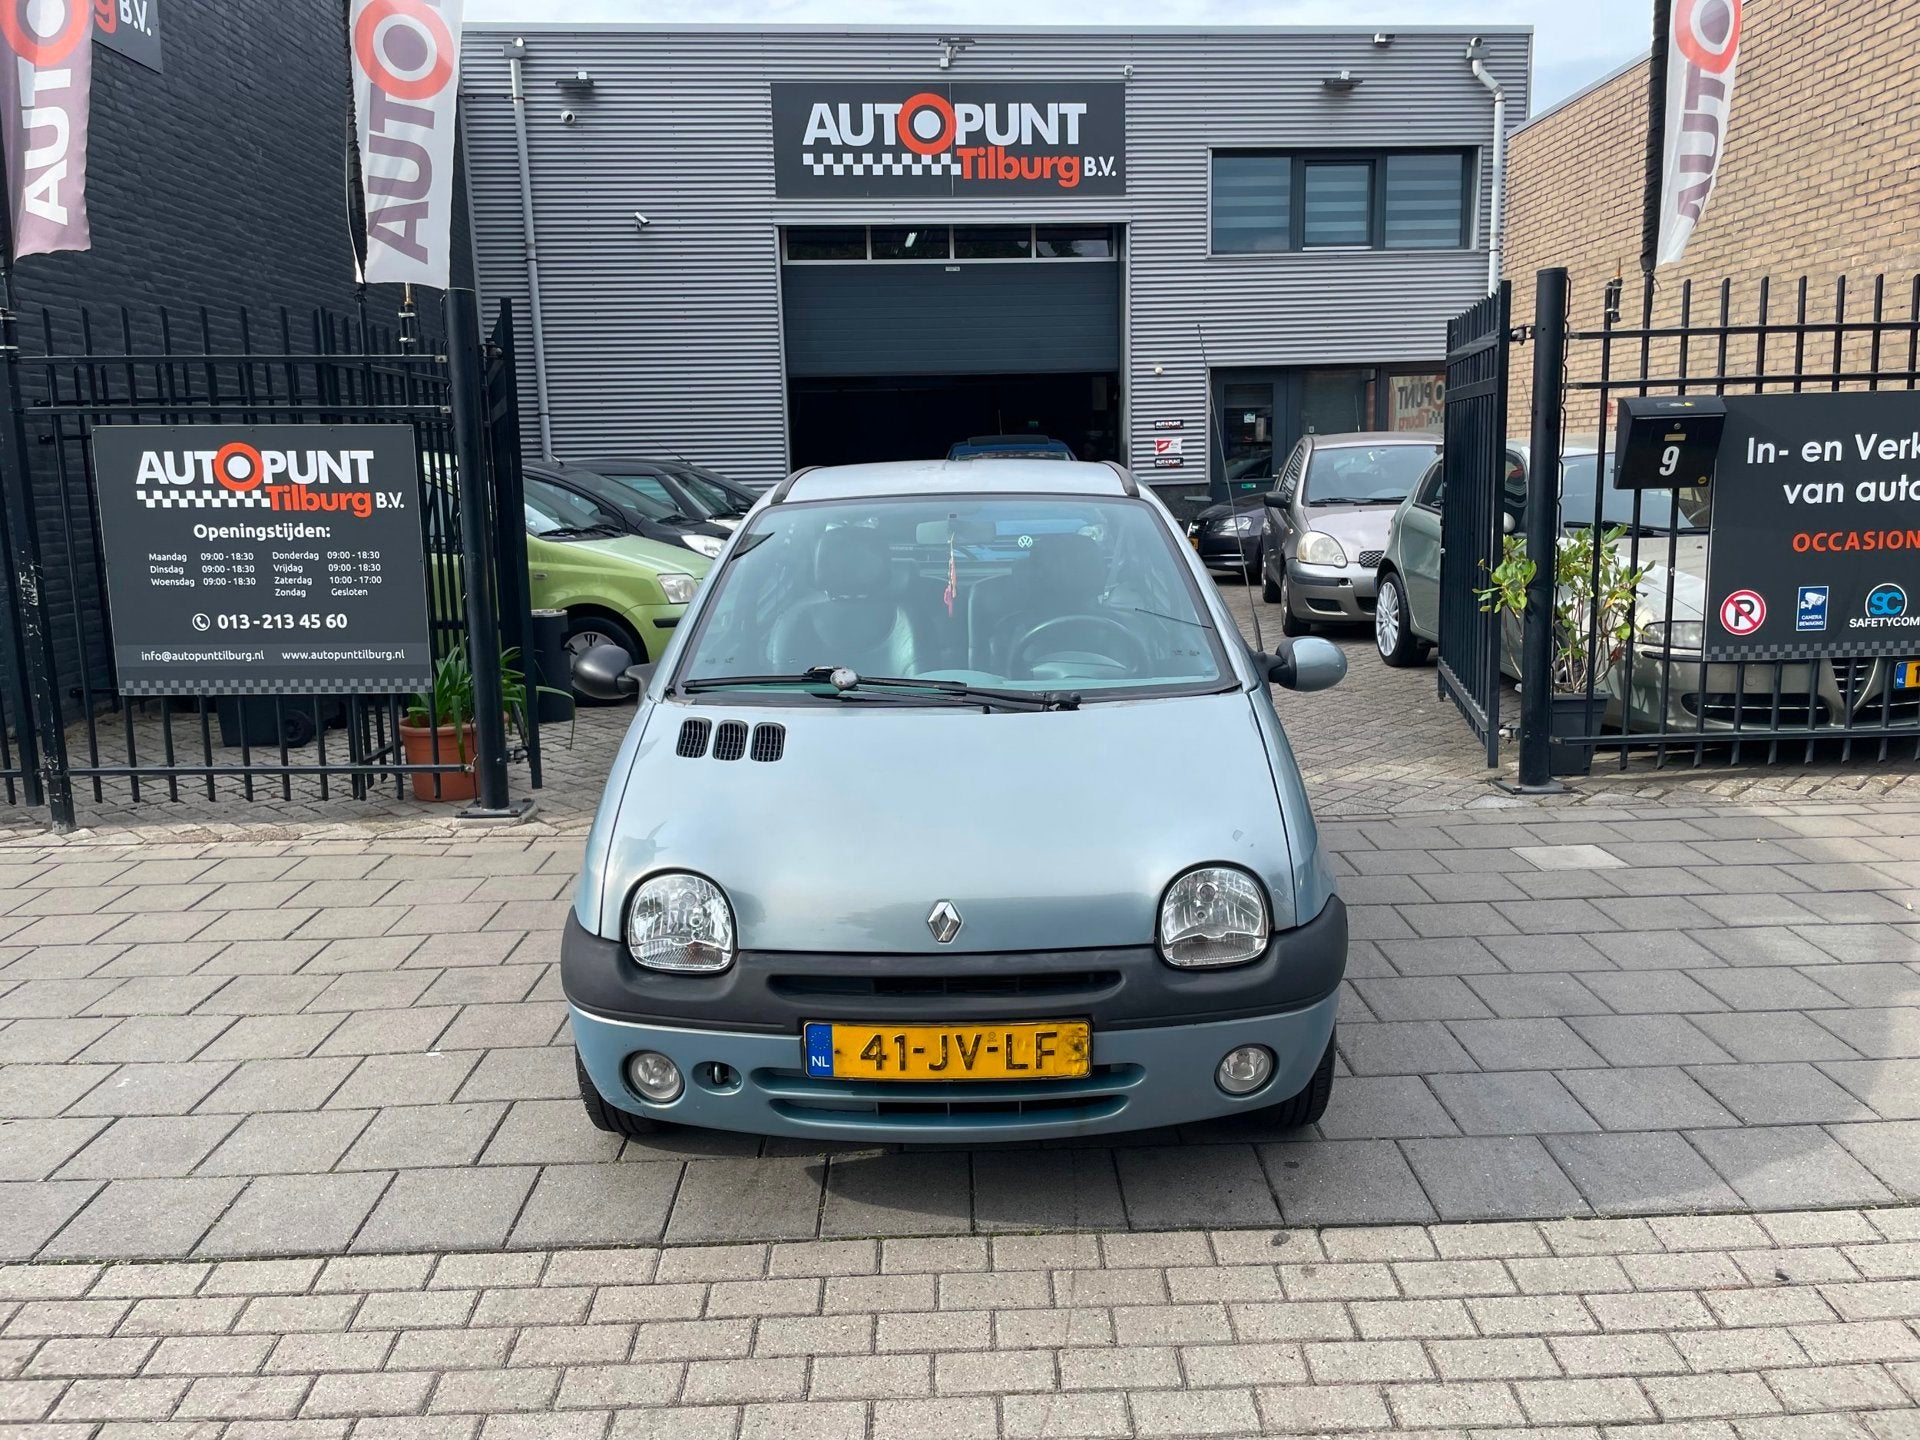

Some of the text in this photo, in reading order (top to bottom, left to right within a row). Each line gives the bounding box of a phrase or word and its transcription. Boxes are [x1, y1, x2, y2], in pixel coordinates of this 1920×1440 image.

[802, 93, 1087, 155] AUTOPUNT
[957, 146, 1116, 188] Tilburg B.V.
[1748, 438, 1788, 463] In-
[1802, 441, 1842, 462] en
[136, 442, 375, 492] AUTOPUNT
[1660, 446, 1679, 475] 9
[265, 484, 404, 518] Tilburg B.V.
[1784, 483, 1843, 504] van
[194, 523, 330, 541] Openingstijden:
[1793, 530, 1920, 552] OCCASION
[148, 552, 188, 563] Maandag
[200, 552, 225, 561] 09:00
[230, 552, 254, 561] 18:30
[272, 550, 320, 561] Donderdag
[326, 551, 351, 560] 09:00
[357, 550, 380, 560] 18:30
[149, 564, 184, 575] Dinsdag
[201, 564, 226, 574] 09:00
[232, 564, 255, 573] 18:30
[272, 563, 304, 574] Vrijdag
[328, 563, 352, 572] 09:00
[358, 563, 381, 572] 18:30
[150, 577, 195, 588] Woensdag
[202, 577, 227, 586] 09:00
[233, 577, 257, 586] 18:30
[274, 575, 313, 586] Zaterdag
[329, 575, 353, 585] 10:00
[359, 575, 383, 584] 17:00
[274, 587, 368, 598] Zondag Gesloten
[300, 614, 320, 628] 45
[326, 614, 347, 628] 60
[141, 649, 265, 663] info@autopunttilburg.nl
[281, 648, 405, 662] www.autopunttilburg.nl
[811, 1031, 1058, 1071] NL 41-JV-LF
